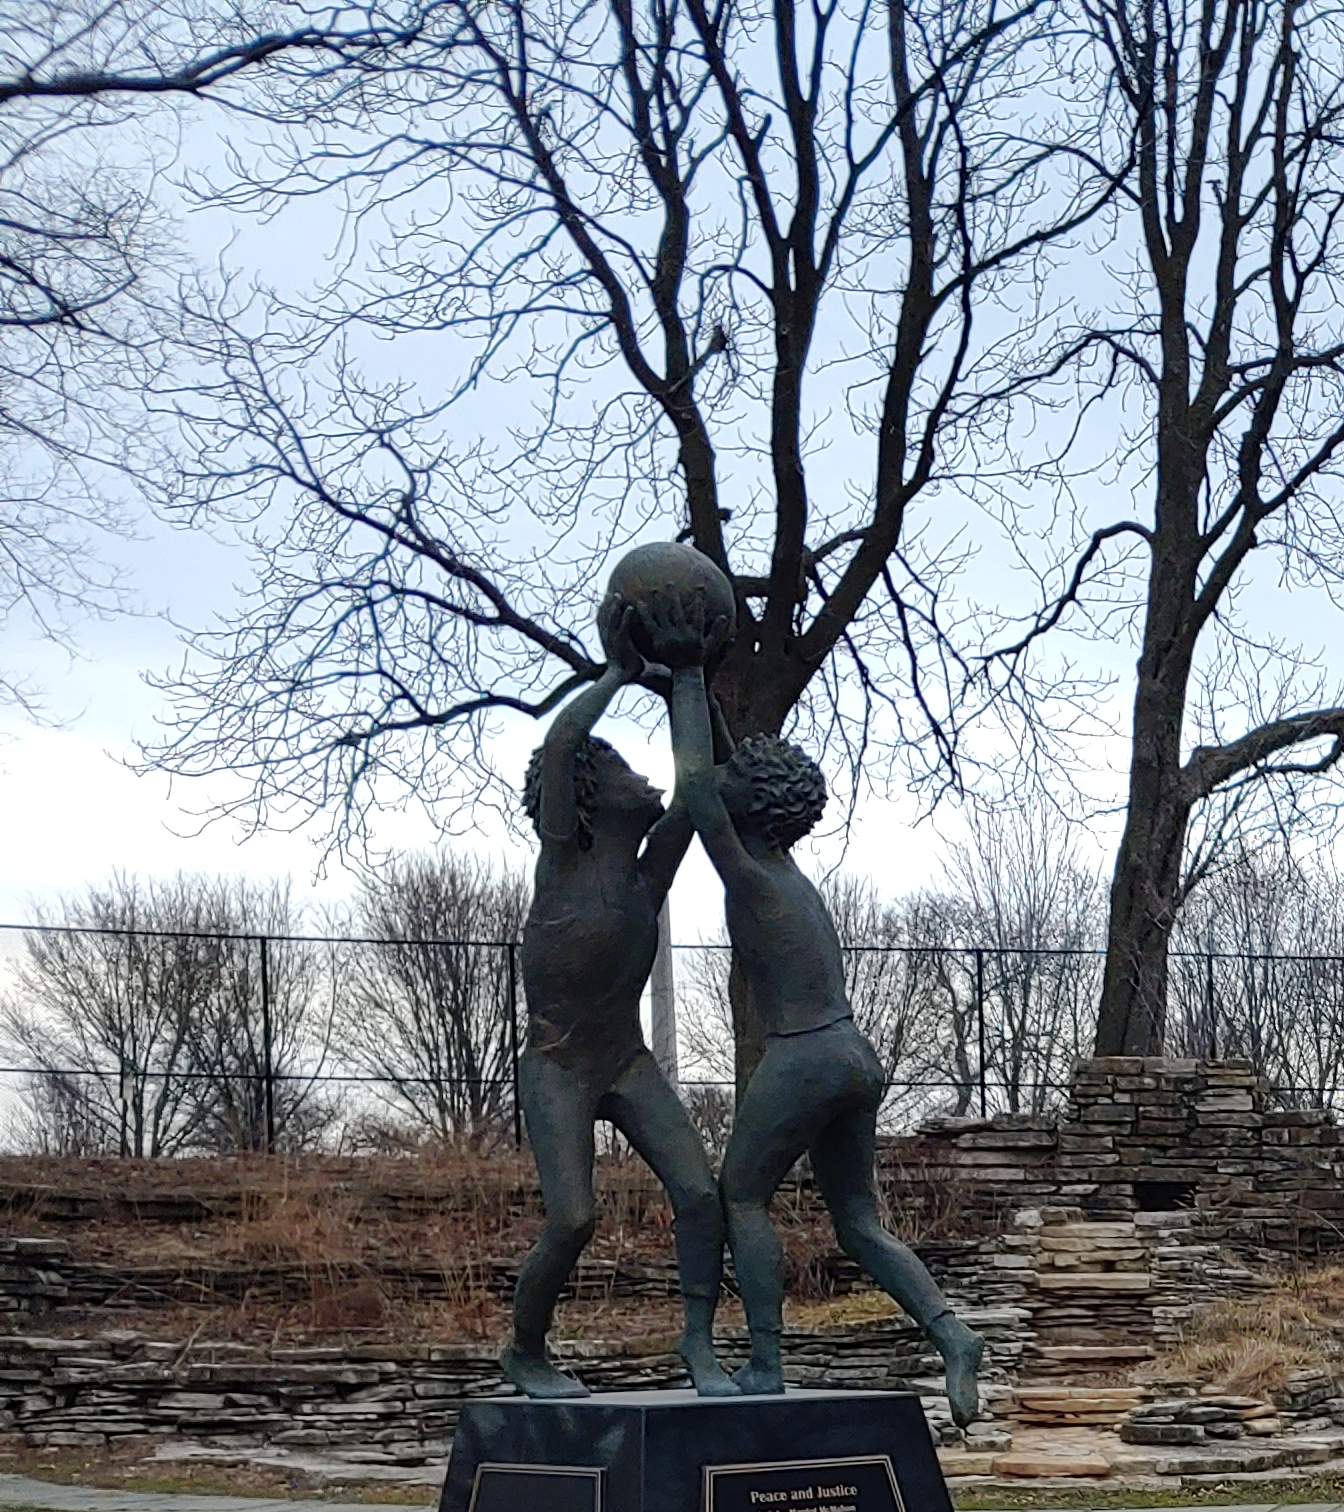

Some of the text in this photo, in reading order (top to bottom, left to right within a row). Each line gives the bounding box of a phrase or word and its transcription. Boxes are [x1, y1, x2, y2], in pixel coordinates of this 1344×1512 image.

[751, 1485, 858, 1504] Peace and Justice
